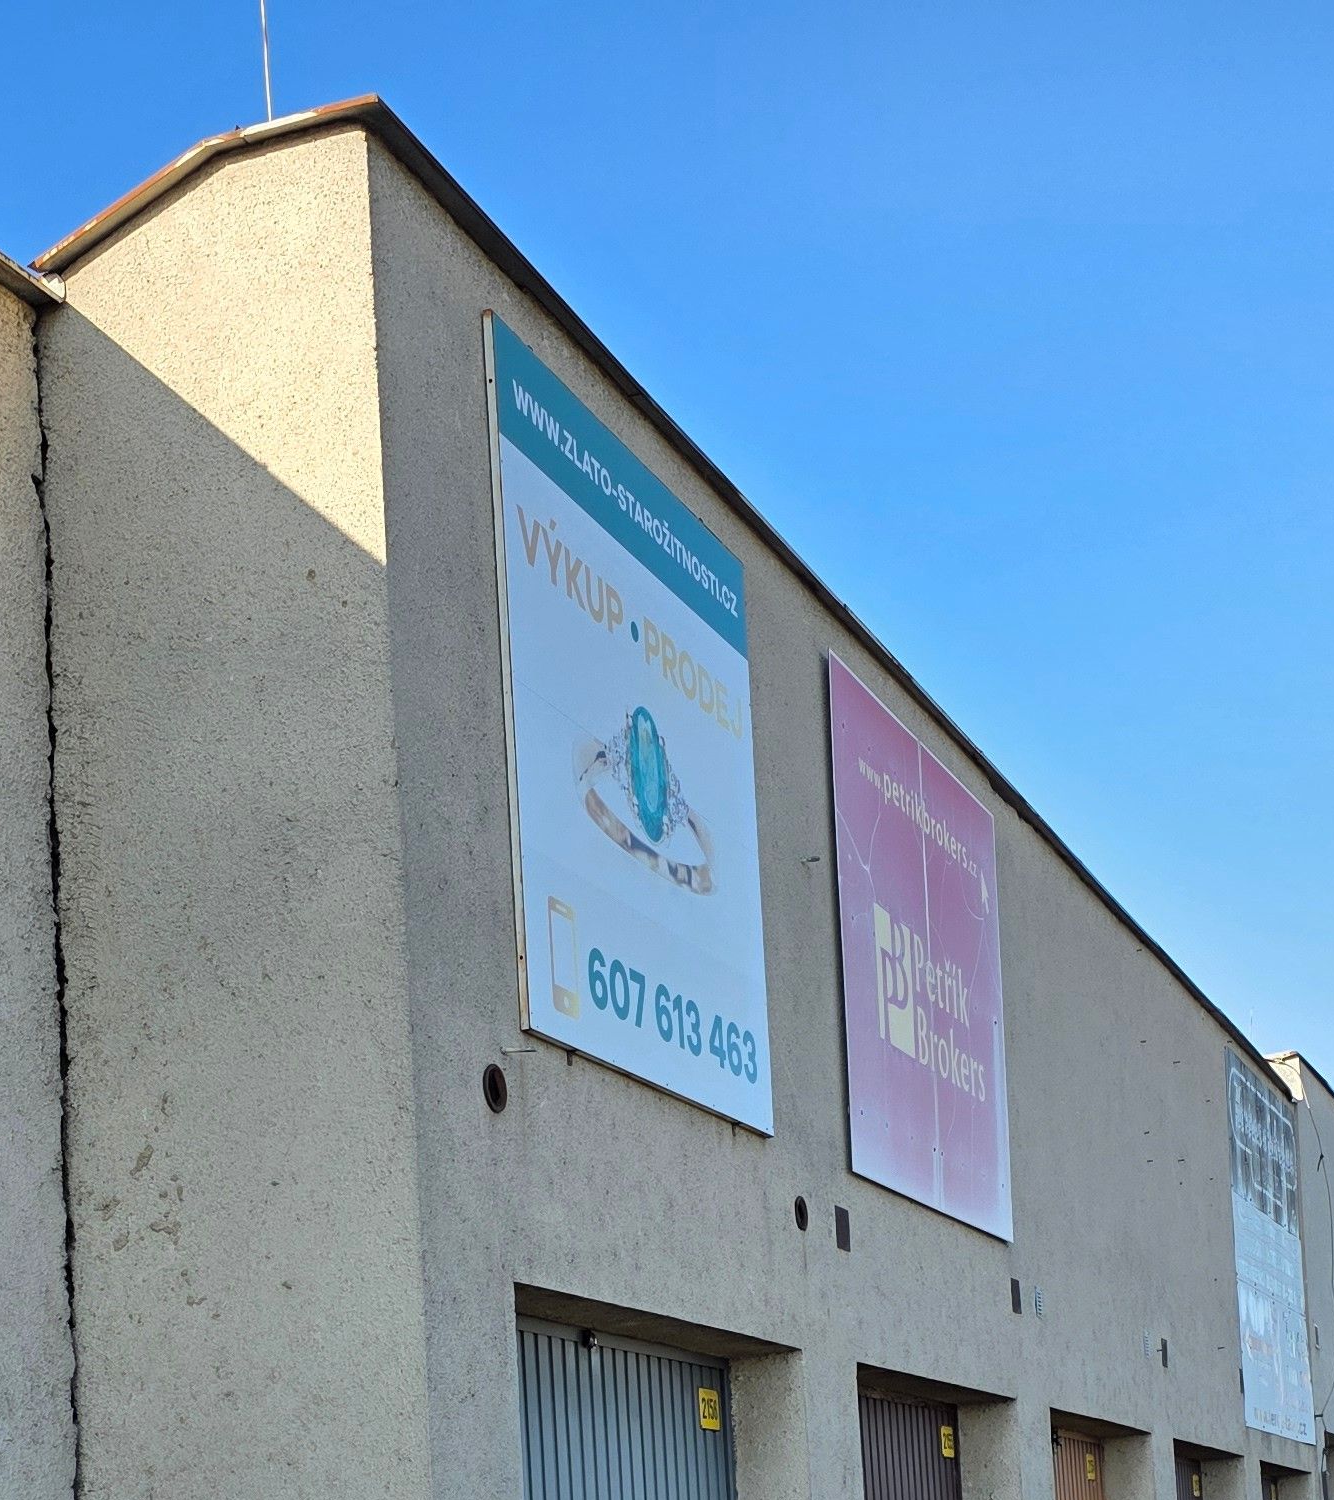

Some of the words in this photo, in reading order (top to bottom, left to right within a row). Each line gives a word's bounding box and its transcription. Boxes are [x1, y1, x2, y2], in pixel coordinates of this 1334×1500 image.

[512, 378, 739, 618] WWW.ZLATO-STAROŽITNOSTI.CZ
[516, 504, 623, 634] VÝKUP
[642, 614, 744, 740] PRODEJ
[857, 756, 978, 879] www.petrikbrokers.cz
[587, 947, 645, 1029] 607
[654, 982, 702, 1057] 613
[709, 1014, 758, 1084] 463
[913, 933, 970, 1029] Petřík
[916, 1005, 986, 1103] Brokers
